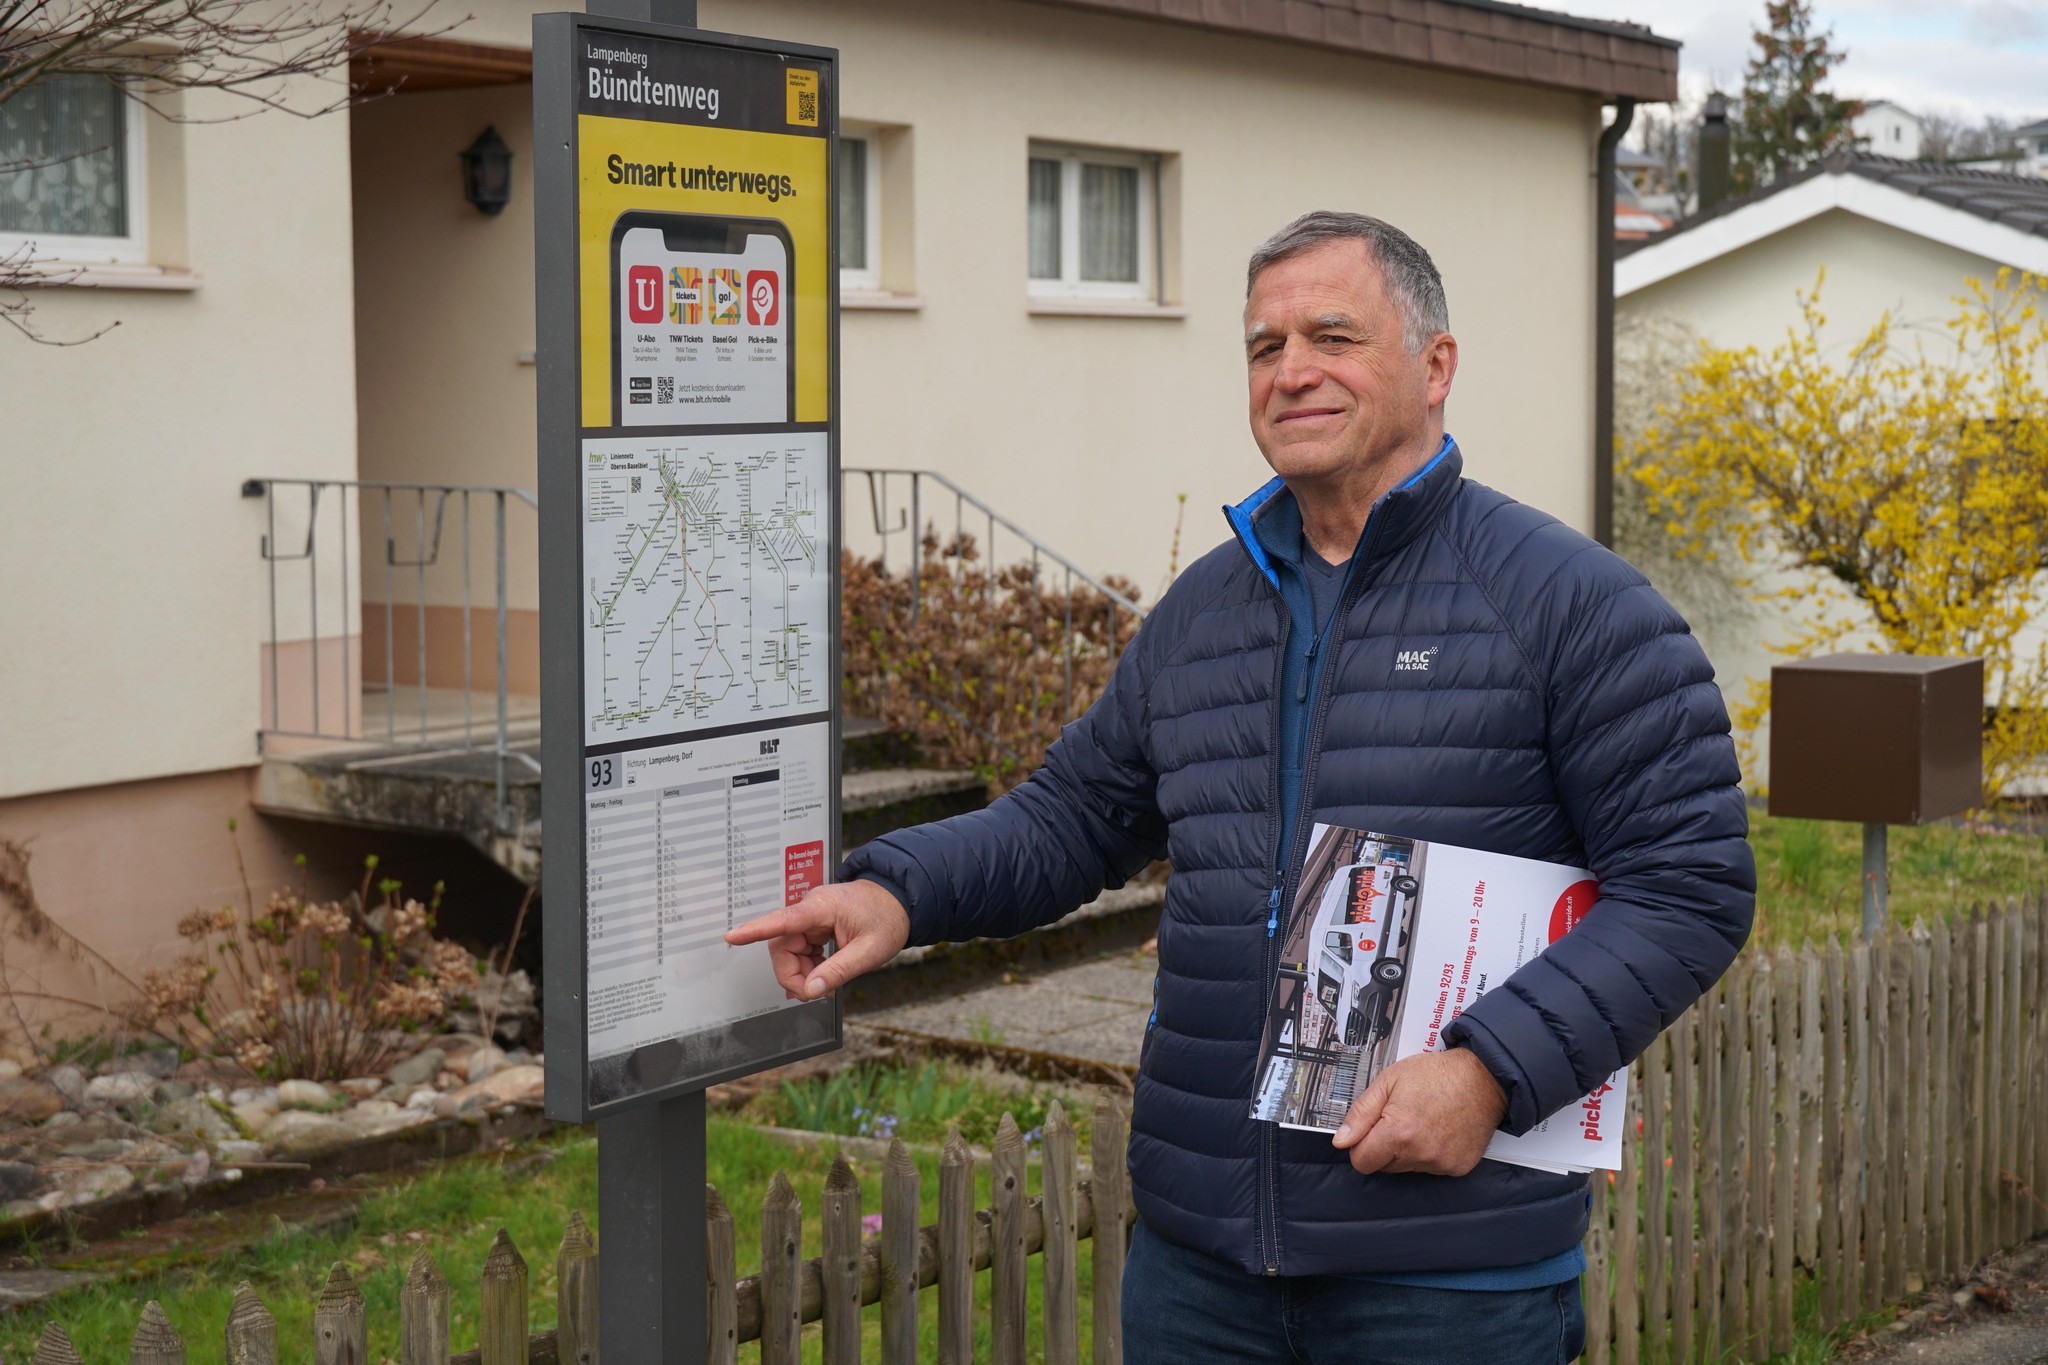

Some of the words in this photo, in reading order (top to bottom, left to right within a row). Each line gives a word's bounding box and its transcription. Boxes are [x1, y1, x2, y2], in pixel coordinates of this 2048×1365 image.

[587, 44, 648, 69] Lampenberg
[588, 67, 719, 120] Bündtenweg
[607, 154, 676, 188] Smart
[680, 164, 797, 203] unterwegs.
[676, 291, 696, 300] tickets
[718, 292, 731, 304] go!
[669, 335, 682, 343] TNW
[683, 335, 703, 343] Tickets
[712, 335, 727, 343] Basel
[748, 336, 778, 344] Pick-e-Bike
[679, 384, 691, 392] Jetzt
[691, 384, 714, 392] kostenlos
[679, 395, 731, 404] www.blt.ch/mobile
[1396, 650, 1430, 663] MAC
[1395, 663, 1403, 671] IN
[1404, 663, 1411, 671] A
[1411, 663, 1429, 671] SAC
[760, 739, 779, 755] BLT
[591, 759, 613, 787] 93
[627, 759, 646, 768] Richtung
[648, 752, 680, 765] Lampenberg,
[681, 750, 693, 760] Dorf
[663, 789, 680, 797] Samstag
[590, 801, 606, 809] Montag
[609, 799, 623, 807] Freitag
[1475, 880, 1486, 895] Uhr
[1473, 896, 1483, 908] 20
[1469, 927, 1478, 942] von
[1460, 945, 1477, 985] sonntags
[1440, 963, 1455, 988] 92/93
[1477, 973, 1487, 991] Abruf.
[1456, 987, 1466, 1003] und
[1429, 991, 1448, 1029] Buslinien
[1425, 1032, 1437, 1047] den
